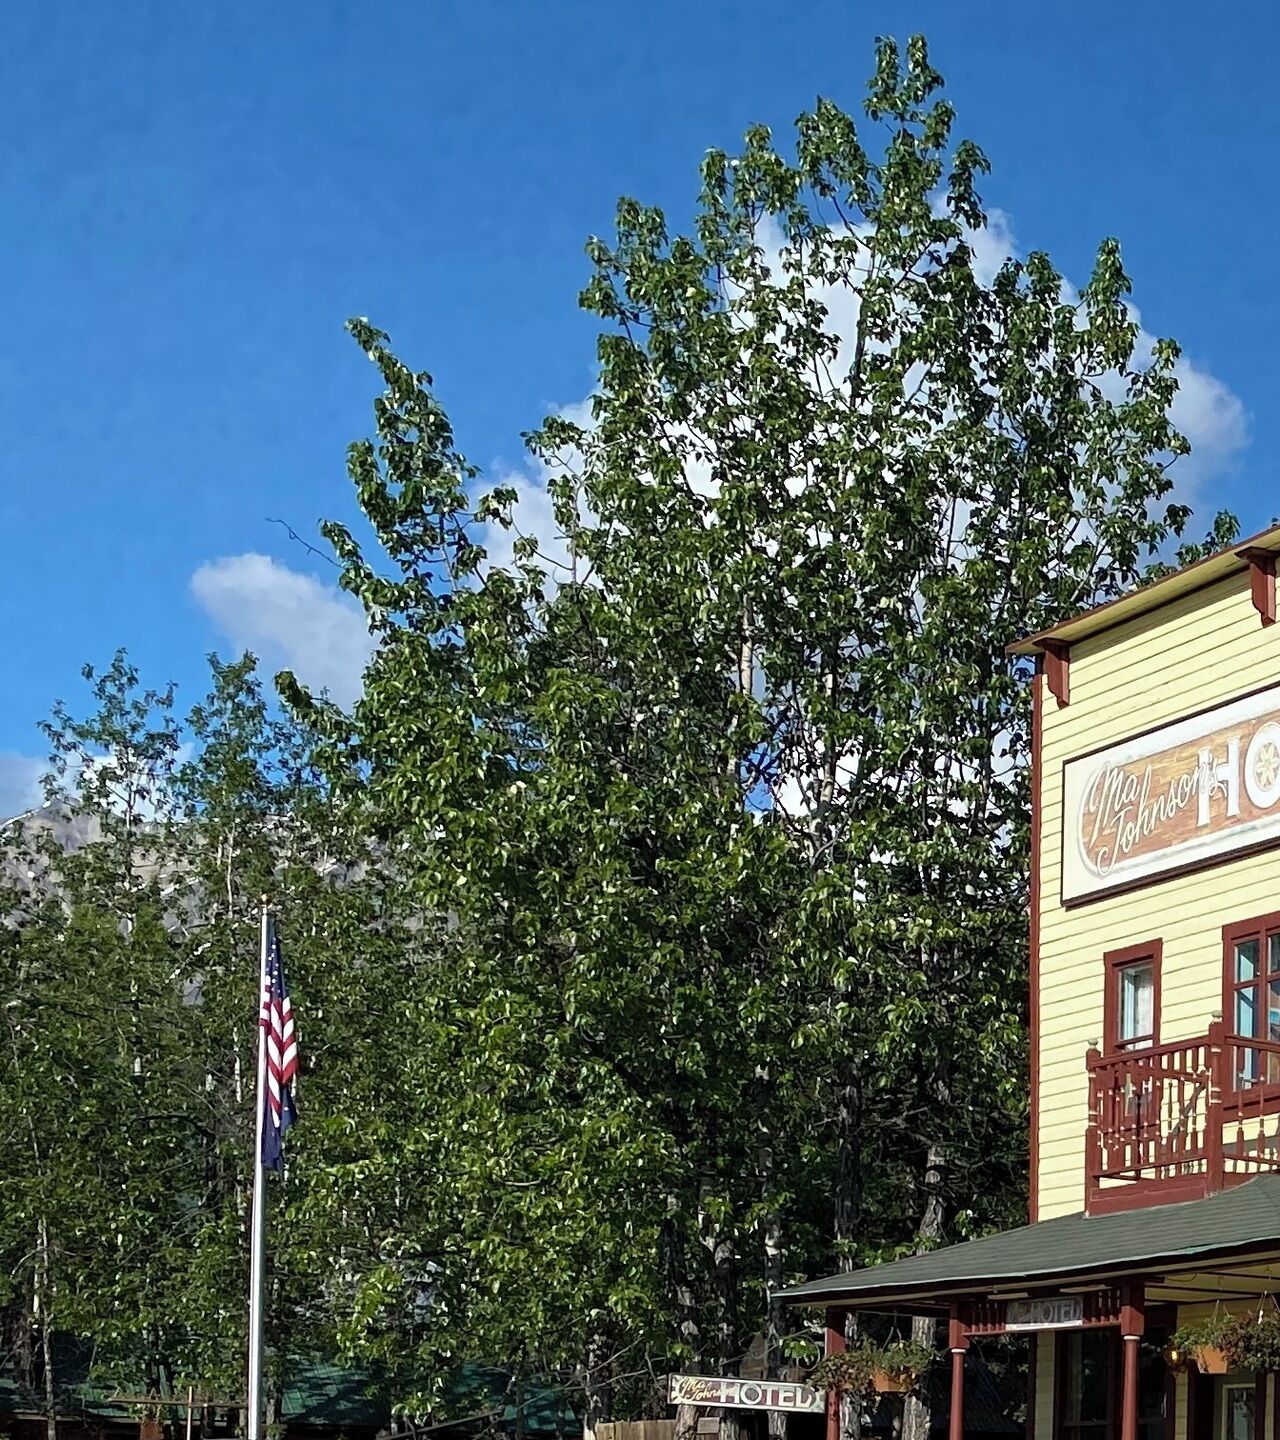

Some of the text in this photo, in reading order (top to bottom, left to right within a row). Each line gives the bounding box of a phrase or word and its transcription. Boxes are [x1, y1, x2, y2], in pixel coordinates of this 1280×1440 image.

[1089, 761, 1141, 849] Ma
[1097, 751, 1228, 876] Johnson's
[719, 1382, 815, 1409] HOTEL
